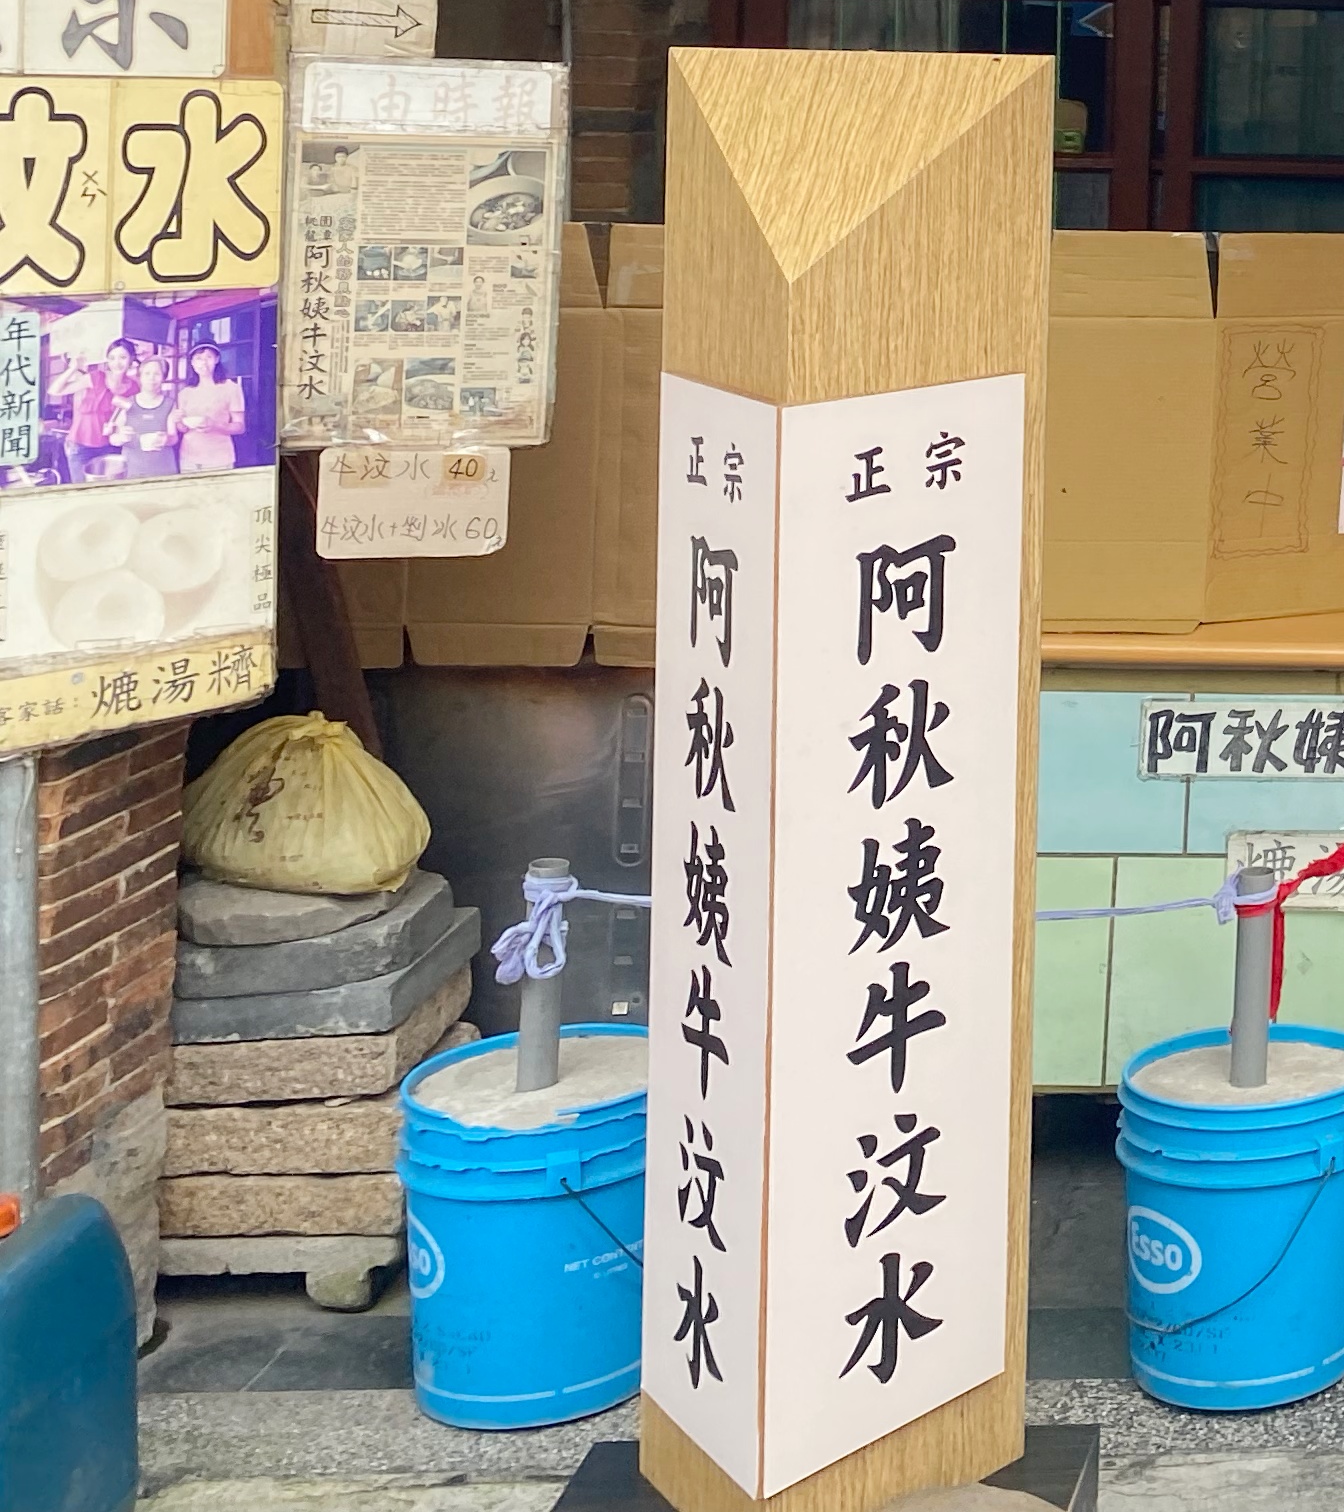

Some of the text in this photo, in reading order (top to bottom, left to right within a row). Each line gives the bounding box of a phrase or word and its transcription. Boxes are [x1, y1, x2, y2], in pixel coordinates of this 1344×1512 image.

[0, 317, 37, 458] 年代新聞
[297, 244, 334, 400] 阿秋姨牛汶水
[685, 434, 746, 502] 正宗
[844, 430, 967, 504] 正宗
[253, 505, 273, 611] 頂尖極品
[671, 534, 739, 1390] 阿秋姨牛汶水
[838, 533, 957, 1386] 阿秋姨牛汶水
